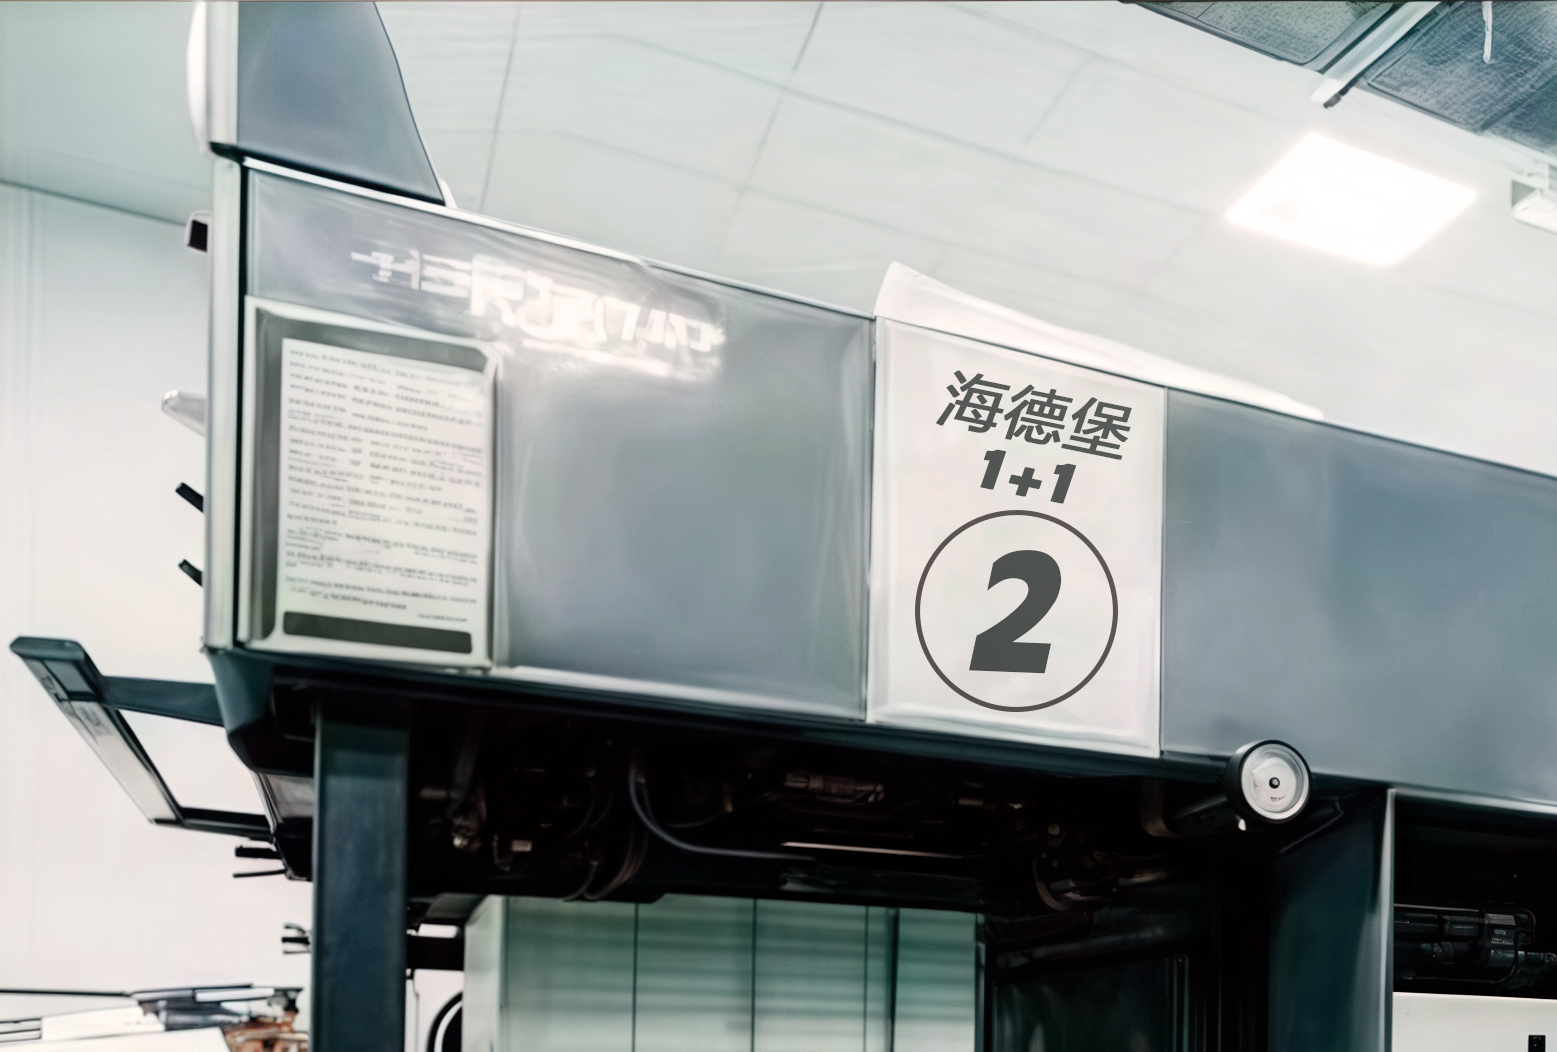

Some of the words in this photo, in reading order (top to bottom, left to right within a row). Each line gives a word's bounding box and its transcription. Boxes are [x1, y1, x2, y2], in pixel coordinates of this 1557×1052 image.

[936, 370, 1132, 461] 海德堡
[980, 449, 1077, 504] 1+1
[968, 549, 1062, 674] 2
